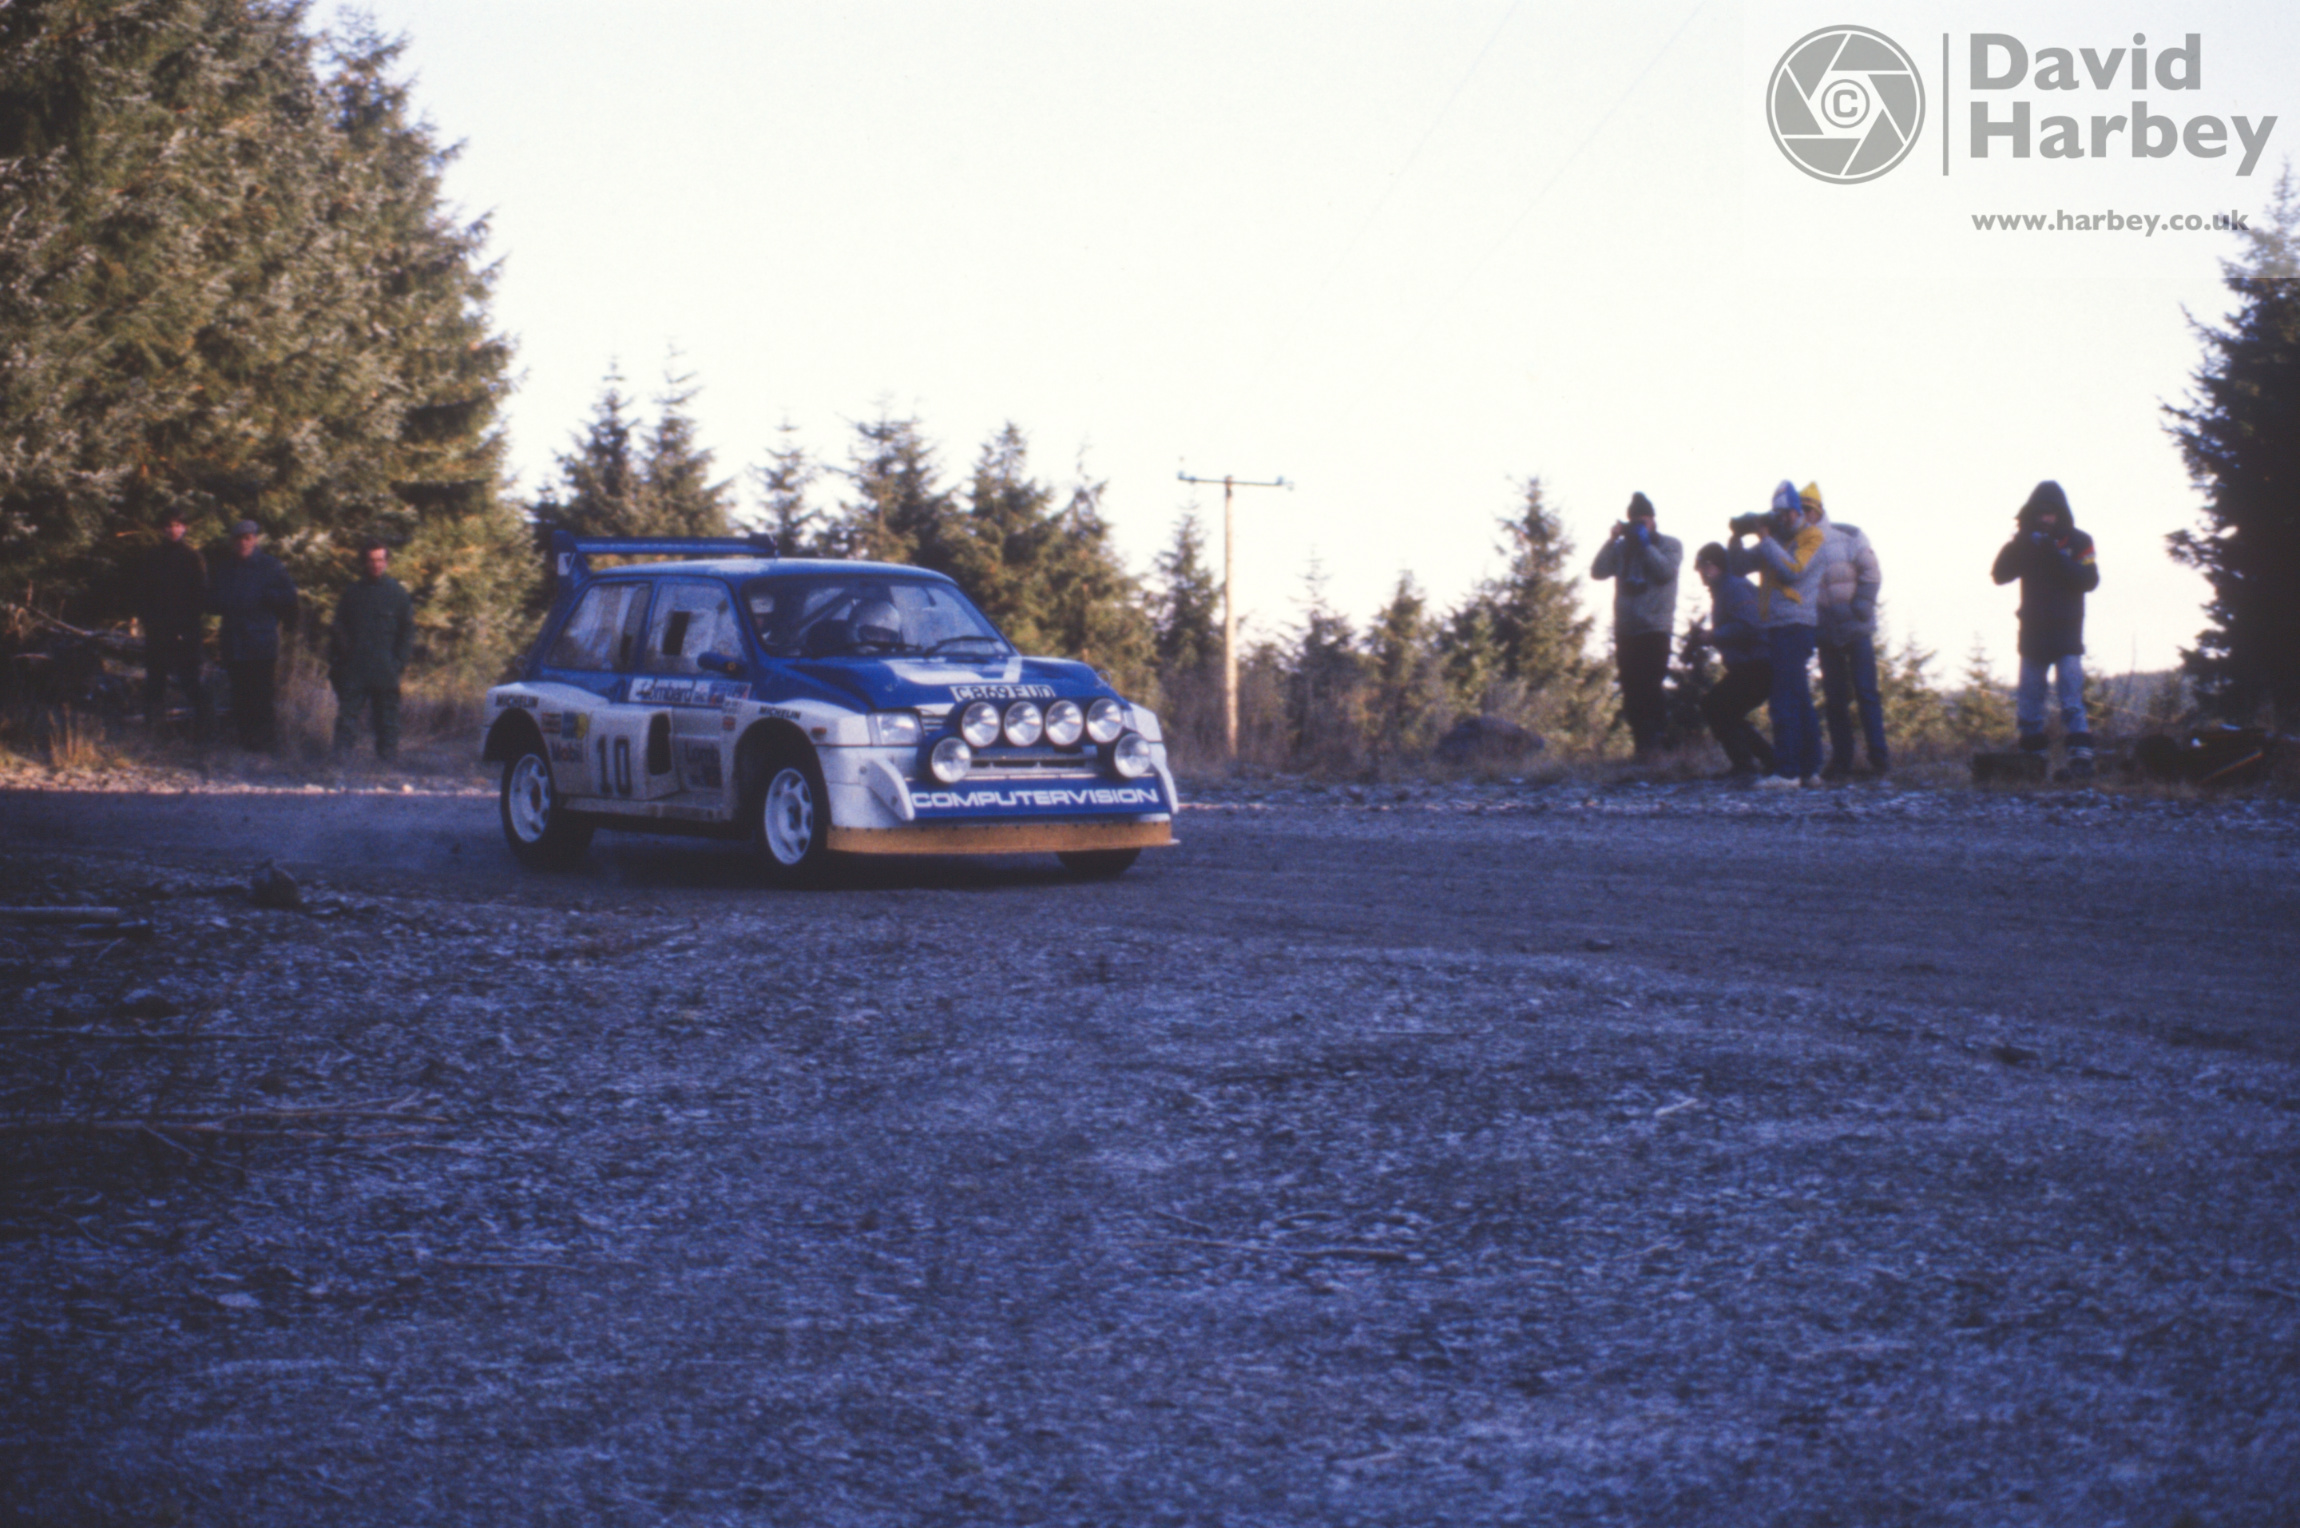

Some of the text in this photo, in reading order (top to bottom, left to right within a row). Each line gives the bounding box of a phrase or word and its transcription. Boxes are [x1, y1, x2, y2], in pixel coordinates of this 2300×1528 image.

[496, 693, 539, 709] MICHELIN
[759, 705, 802, 721] MICHELIN
[598, 734, 632, 795] 10
[912, 788, 1159, 808] COMPUTERVISION
